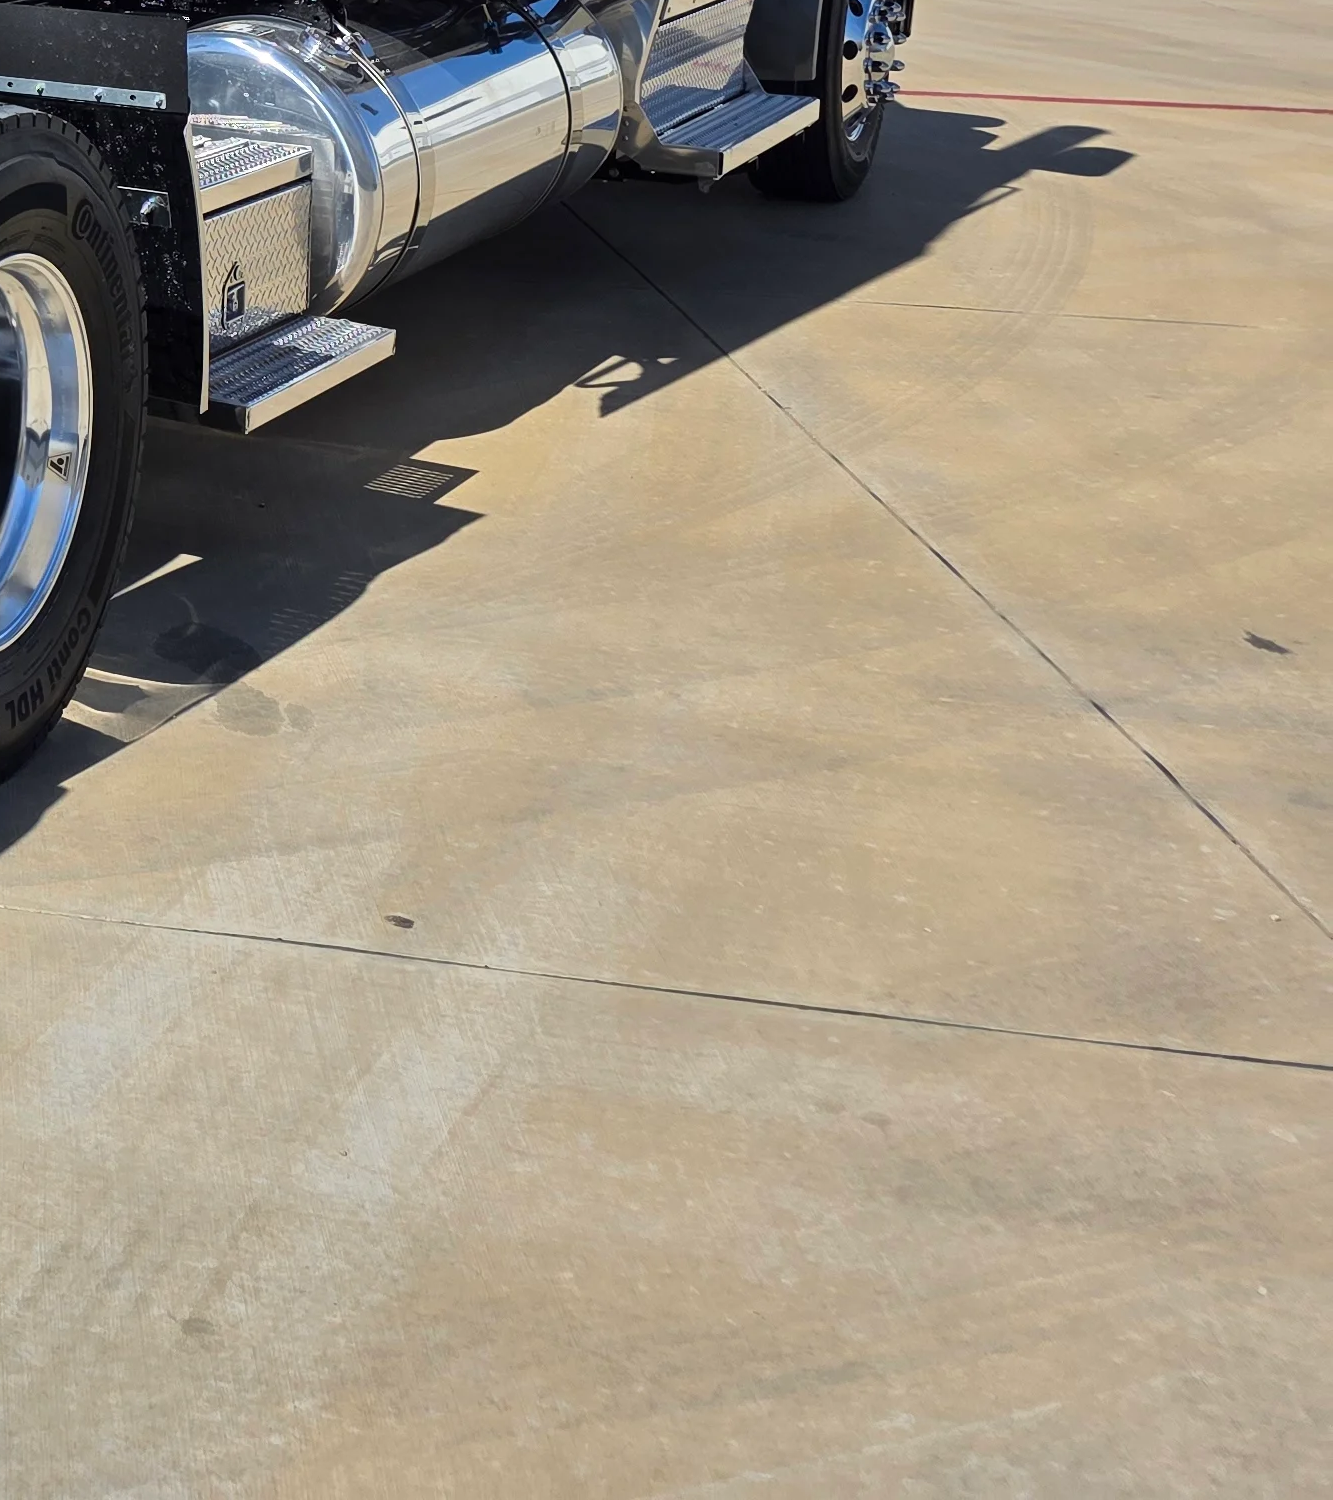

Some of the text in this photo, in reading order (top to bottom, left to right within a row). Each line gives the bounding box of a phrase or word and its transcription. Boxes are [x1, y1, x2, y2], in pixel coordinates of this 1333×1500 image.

[71, 198, 137, 363] Continental
[45, 606, 92, 692] Conti
[4, 676, 46, 730] HDL
